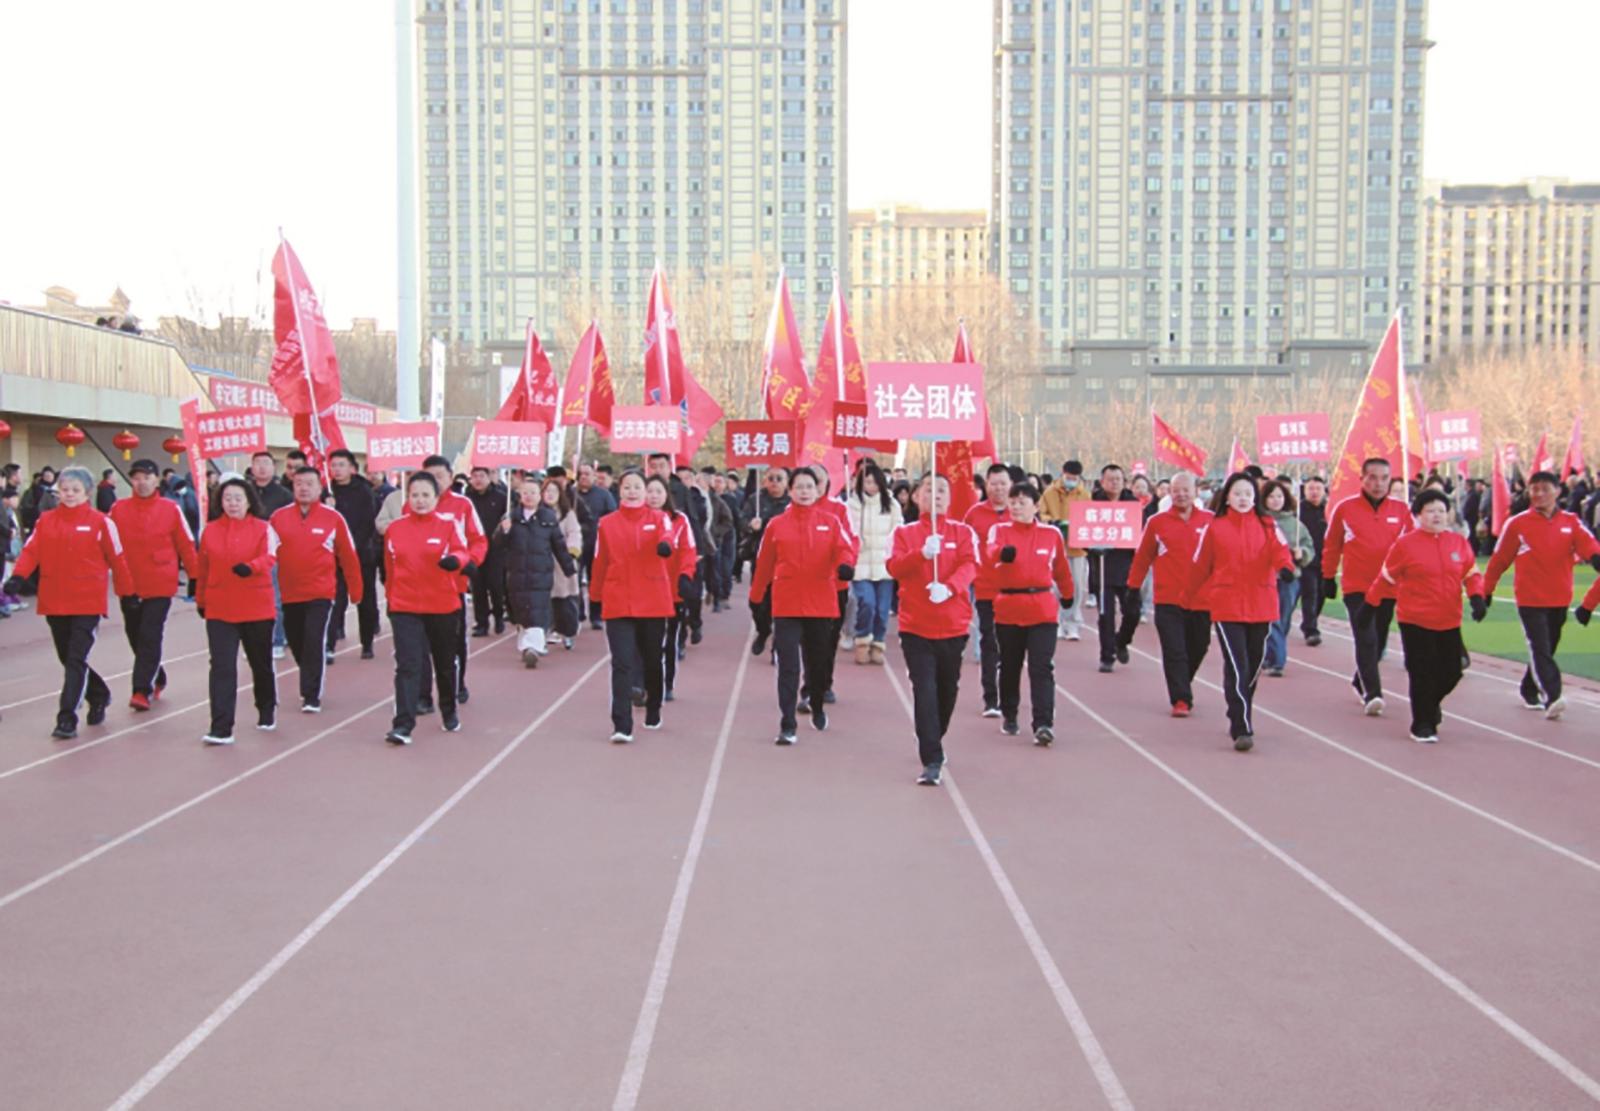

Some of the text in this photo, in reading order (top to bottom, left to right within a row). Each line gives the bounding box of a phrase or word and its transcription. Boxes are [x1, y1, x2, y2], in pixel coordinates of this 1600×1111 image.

[874, 384, 976, 420] 社会团体
[613, 419, 679, 440] 巴市市政公司
[369, 435, 436, 458] 临河城投公司
[732, 432, 790, 456] 税务局
[1085, 507, 1128, 523] 临河区
[1077, 526, 1134, 541] 生态分局
